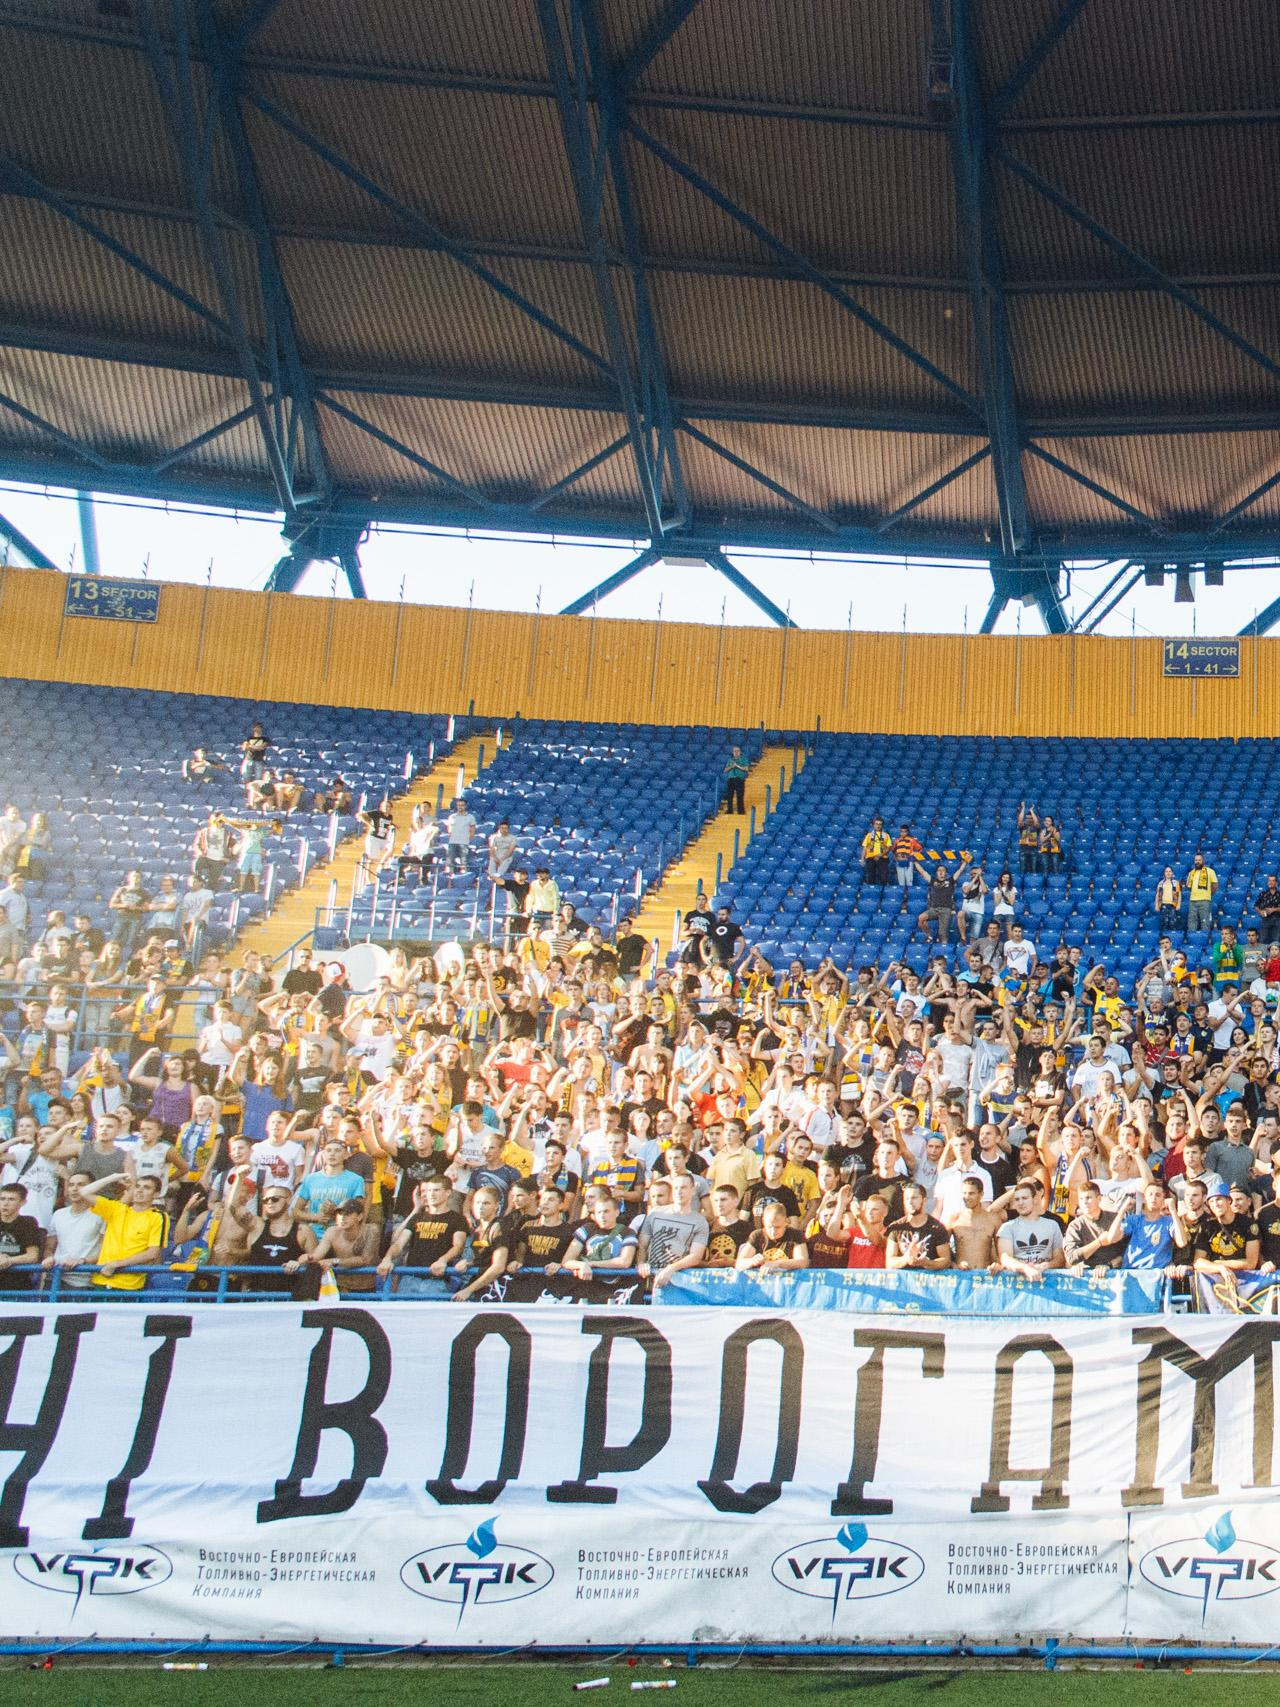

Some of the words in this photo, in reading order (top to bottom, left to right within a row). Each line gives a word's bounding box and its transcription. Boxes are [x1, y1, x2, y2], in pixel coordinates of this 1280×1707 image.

[71, 580, 98, 600] 13
[101, 586, 157, 600] SECTOR
[1166, 642, 1189, 659] 14
[1190, 646, 1238, 656] SECTOR
[1184, 663, 1191, 674] 1
[1204, 663, 1219, 674] 41
[808, 1271, 827, 1286] IN
[1056, 1276, 1074, 1291] IN
